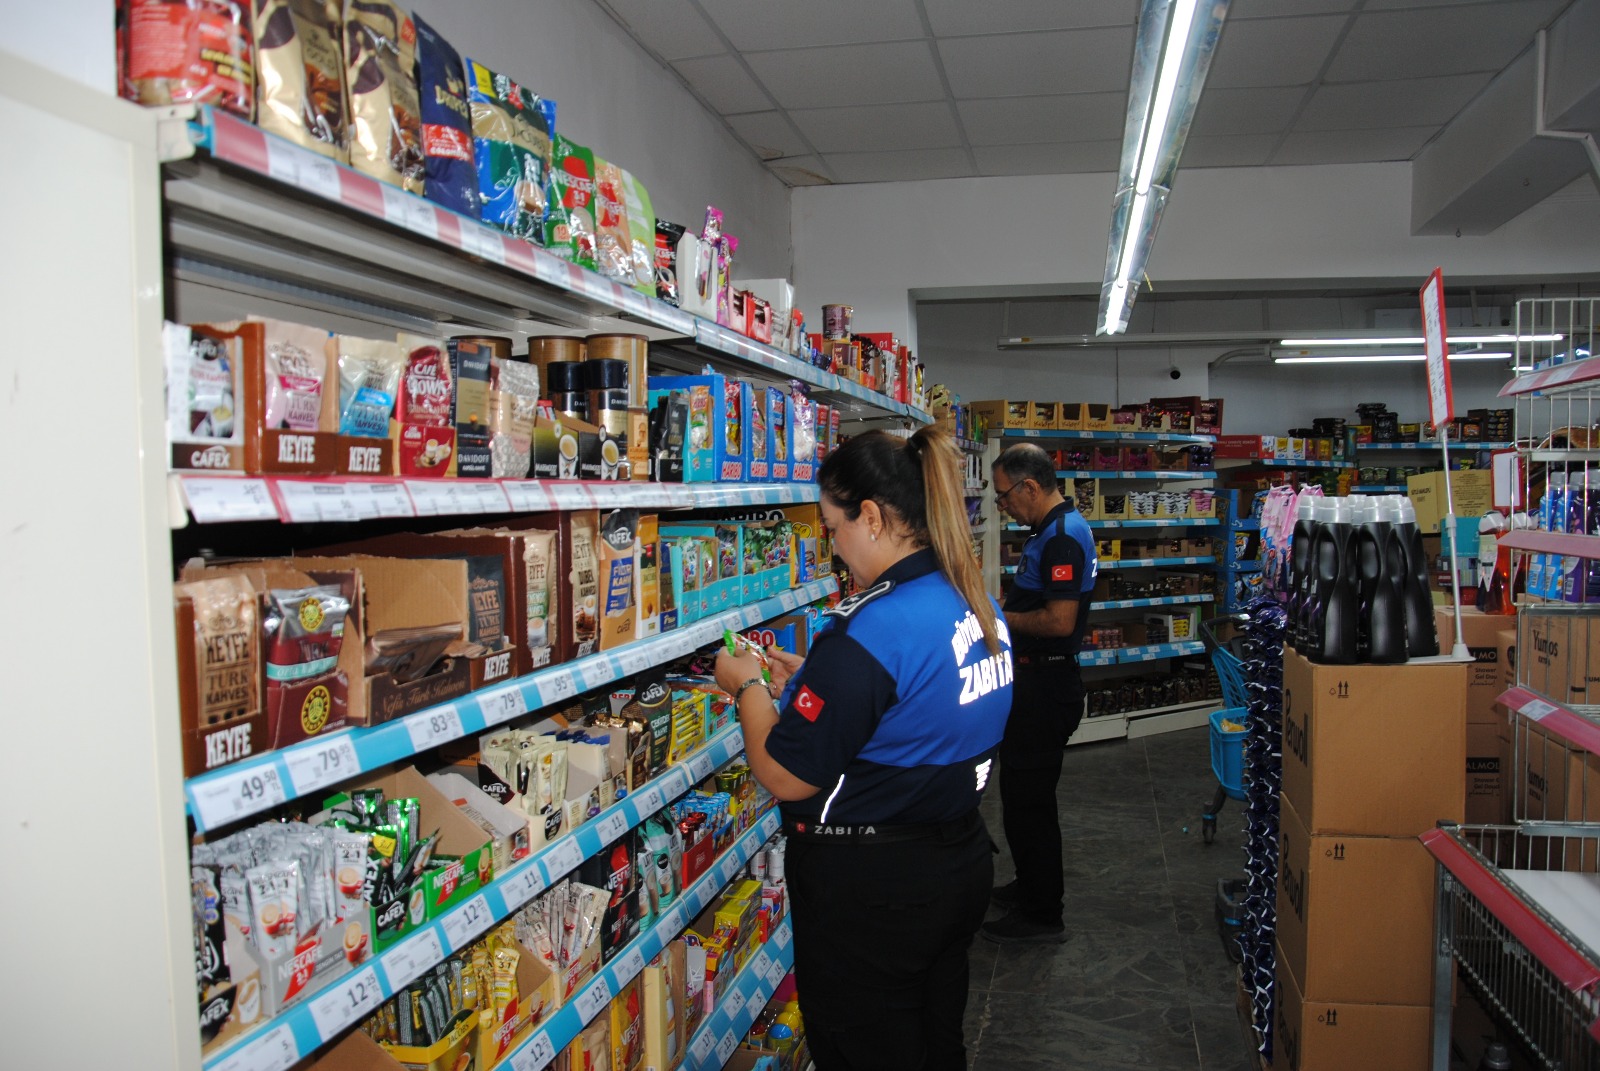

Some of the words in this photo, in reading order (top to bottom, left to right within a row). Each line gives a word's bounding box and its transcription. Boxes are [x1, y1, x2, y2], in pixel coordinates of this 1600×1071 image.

[191, 449, 231, 468] CAFEX
[278, 435, 316, 463] KEYFE
[348, 446, 382, 472] KEYFE
[609, 531, 633, 545] CAFEX
[204, 633, 250, 665] KEYFE
[1533, 629, 1558, 657] Yumos
[484, 652, 511, 681] KEYFE
[959, 649, 1013, 705] ZABITA
[642, 685, 666, 701] CAFEX
[1285, 688, 1308, 768] Perwoll
[205, 722, 252, 768] KEYFE
[482, 784, 507, 793] CAFEX
[814, 825, 876, 835] ZABITA
[363, 856, 381, 902] AFEX
[377, 901, 405, 927] CAFEX
[200, 1000, 230, 1028] AFEX
